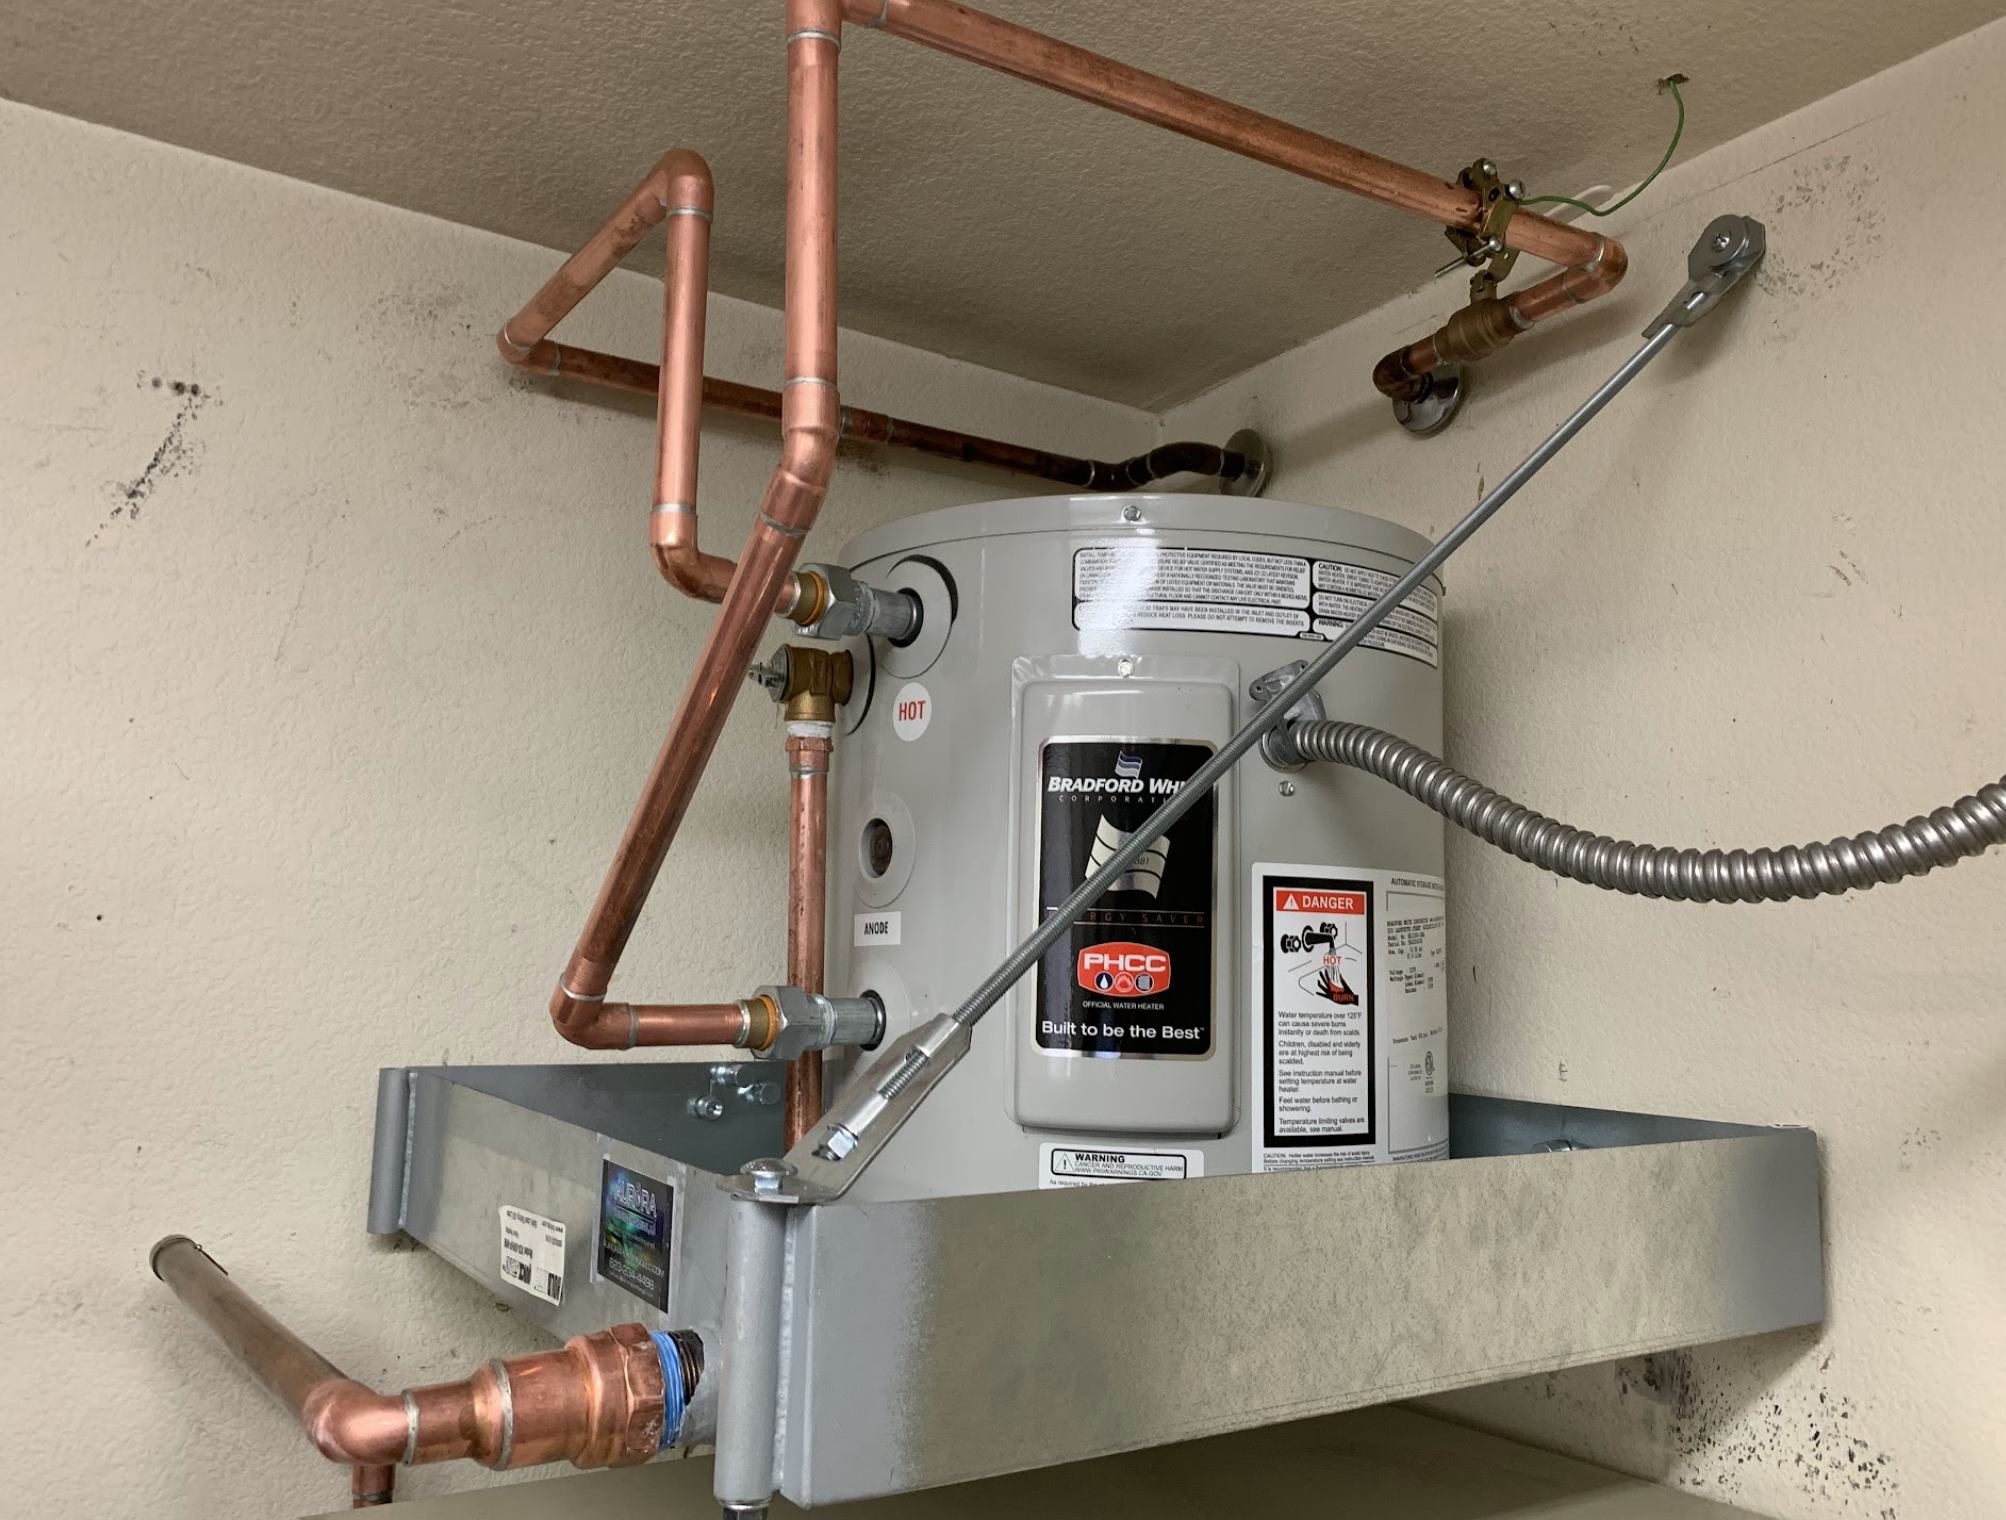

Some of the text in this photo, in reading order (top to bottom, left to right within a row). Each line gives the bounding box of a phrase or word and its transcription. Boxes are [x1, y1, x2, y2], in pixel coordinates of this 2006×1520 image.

[1319, 563, 1342, 572] CAUTION:
[1209, 607, 1234, 615] INSTALLED
[898, 700, 926, 721] HOT
[1048, 776, 1144, 793] BRADFORD
[1058, 794, 1166, 803] CORPORATI
[1134, 857, 1150, 865] 881
[1391, 878, 1416, 887] AUTOMATIC
[1303, 895, 1353, 910] DANGER
[1142, 914, 1203, 924] SAVER
[864, 921, 889, 935] ANODE
[1084, 954, 1166, 972] PHCC
[1323, 956, 1341, 965] HOT
[1333, 994, 1354, 1002] BURN
[1083, 1001, 1111, 1009] OFFICIAL
[1113, 1002, 1136, 1010] WATER
[1042, 1021, 1076, 1035] Built
[1081, 1023, 1097, 1036] to
[1103, 1023, 1124, 1037] be
[1130, 1024, 1156, 1038] the
[1278, 1029, 1304, 1037] instantly
[1332, 1096, 1351, 1104] bathing
[1075, 1153, 1125, 1163] WARNING
[1116, 1163, 1163, 1171] REPRODUCTIVE
